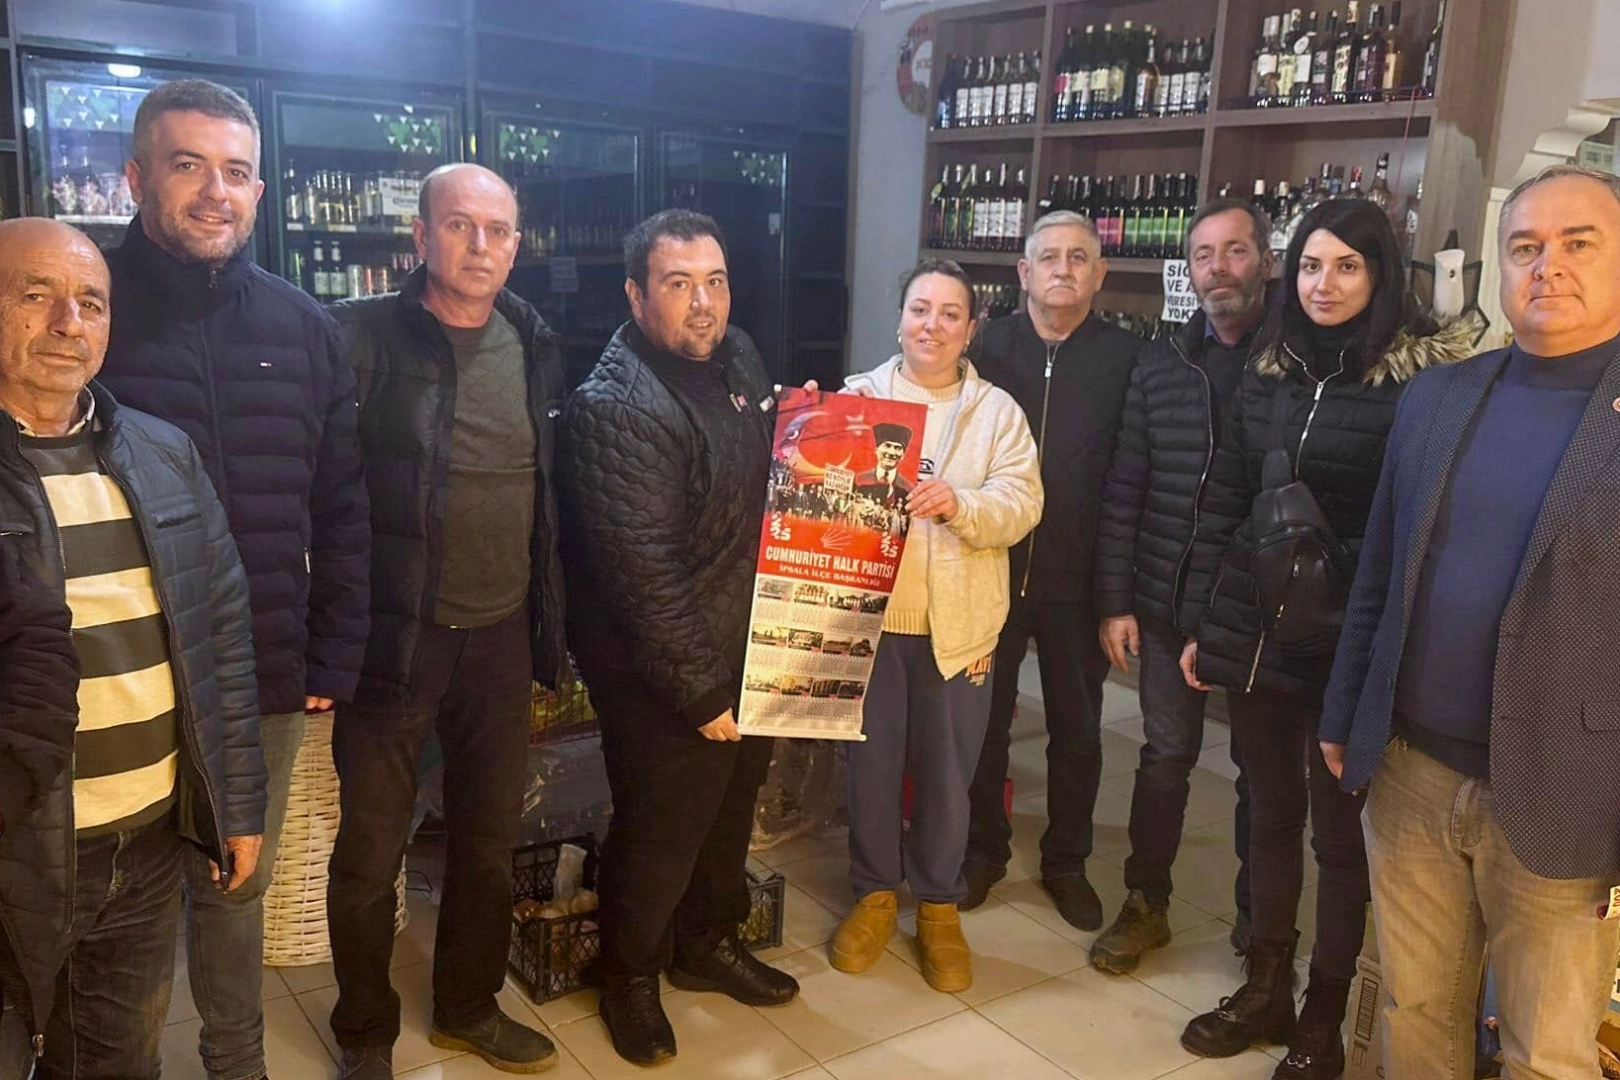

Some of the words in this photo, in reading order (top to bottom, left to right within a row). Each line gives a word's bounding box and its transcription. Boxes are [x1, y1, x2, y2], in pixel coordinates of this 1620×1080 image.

[1167, 279, 1183, 292] VE
[1167, 307, 1197, 320] YOK
[765, 546, 831, 569] CUMHURİYET
[833, 555, 860, 574] HALK
[861, 560, 895, 579] PARTİSİ
[811, 567, 832, 579] İLÇE
